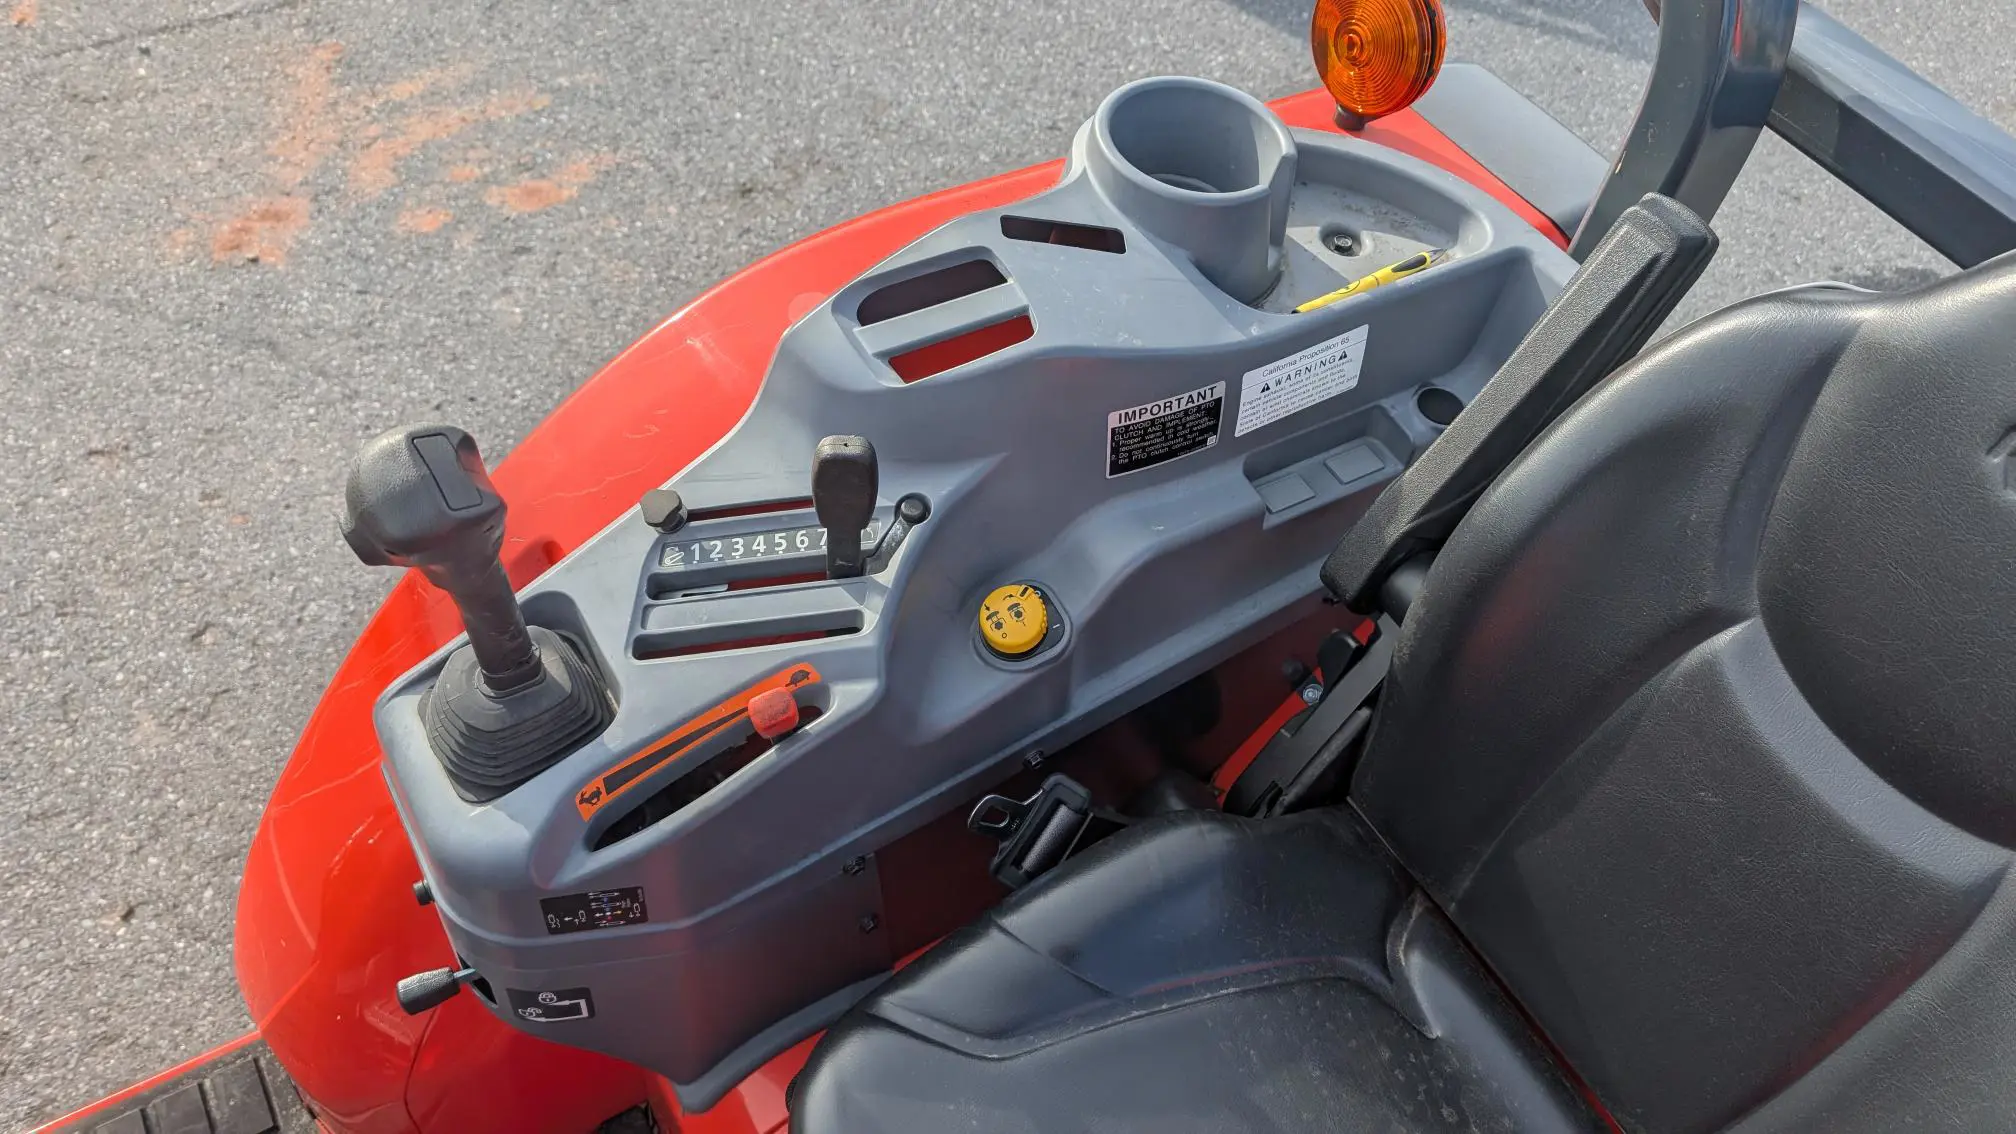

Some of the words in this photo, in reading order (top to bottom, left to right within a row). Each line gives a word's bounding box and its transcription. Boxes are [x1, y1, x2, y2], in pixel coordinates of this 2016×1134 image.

[1262, 357, 1297, 378] California
[1299, 340, 1339, 364] Proposition
[1340, 335, 1350, 346] 65
[1274, 354, 1336, 388] WARNING
[1114, 426, 1125, 435] TO
[1129, 420, 1151, 432] AVOID
[1154, 410, 1185, 425] DAMAGE
[1188, 406, 1198, 415] OF
[1201, 400, 1215, 411] PTO
[1118, 387, 1216, 424] IMPORTANT
[1114, 427, 1144, 443] CLUTCH
[1147, 424, 1163, 434] AND
[1119, 435, 1142, 447] Proper
[1144, 431, 1162, 440] warm
[1119, 434, 1165, 454] recommended
[1176, 427, 1190, 437] cold
[1119, 451, 1129, 460] Do
[1132, 448, 1142, 456] not
[1145, 436, 1184, 454] continuously
[1118, 457, 1129, 465] the
[1132, 452, 1147, 462] PTO
[1150, 445, 1169, 457] clutch
[1171, 438, 1193, 450] control
[690, 543, 700, 561] 1
[709, 540, 723, 558] 2
[731, 538, 744, 556] 3
[752, 535, 767, 553] 4
[774, 532, 787, 551] 5
[795, 530, 809, 548] 6
[817, 528, 828, 547] 7
